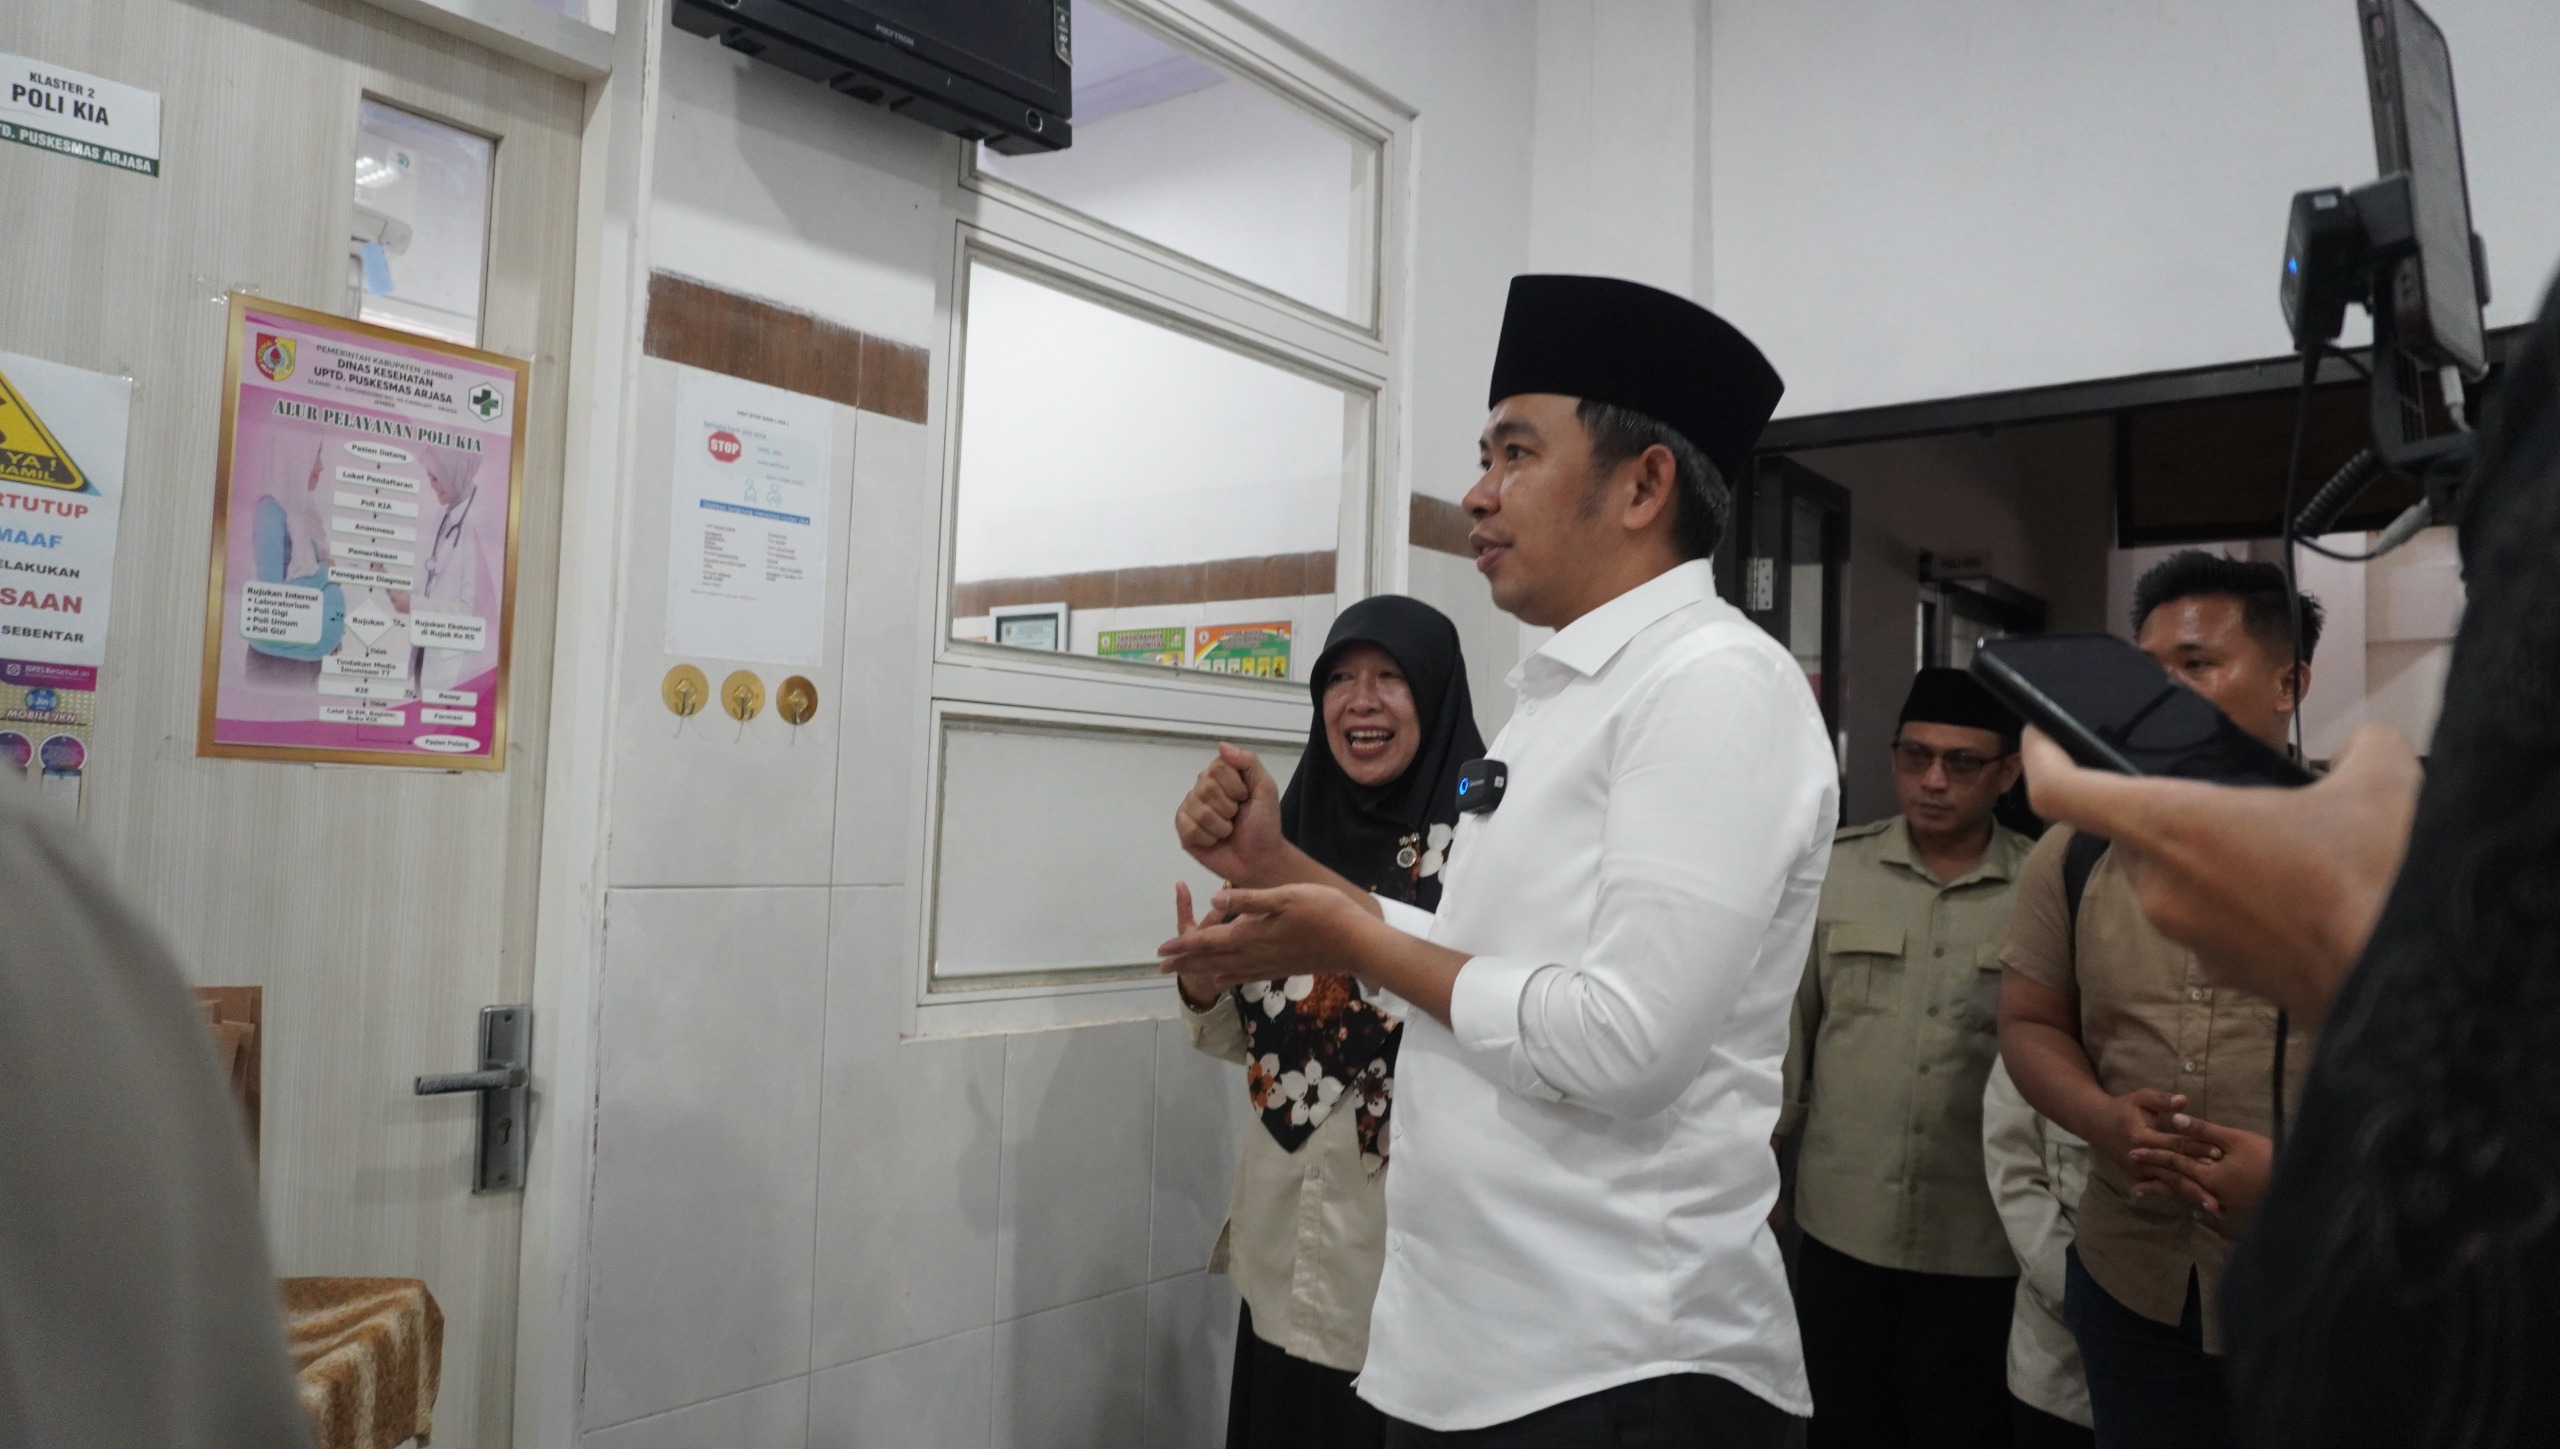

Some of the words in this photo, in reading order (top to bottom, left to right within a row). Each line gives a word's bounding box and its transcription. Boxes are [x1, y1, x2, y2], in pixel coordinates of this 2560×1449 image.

[29, 71, 83, 95] KLASTER
[88, 88, 95, 98] 2
[12, 83, 64, 114] POLI
[74, 100, 109, 126] KIA
[0, 124, 15, 138] D.
[20, 129, 100, 159] PUSKESMAS
[103, 150, 152, 173] ARJASA
[316, 344, 371, 363] PEMERINTAH
[373, 356, 421, 374] KABUPATEN
[423, 367, 454, 381] JEMBER
[338, 358, 371, 375] DINAS
[373, 366, 434, 388] KESEHATAN
[314, 366, 346, 382] UPTD.
[349, 374, 412, 396] PUSKESMAS
[414, 388, 453, 404] ARJASA
[273, 400, 319, 421] ALUR
[323, 408, 413, 440] PELAYANAN
[417, 427, 451, 446] POLI
[455, 437, 482, 453] KIA
[351, 444, 377, 455] Pasien
[379, 448, 407, 461] Datang
[710, 439, 739, 455] STOP
[7, 452, 40, 469] YA
[342, 471, 364, 480] Loket
[366, 474, 413, 489] Pendaftaran
[361, 499, 376, 508] Poli
[377, 502, 392, 510] KIA
[348, 547, 398, 560] Pemeriksaan
[330, 570, 374, 583] Penegakan
[247, 587, 282, 598] Rujukan
[285, 591, 318, 602] Internal
[254, 599, 310, 609] Laboratorium
[253, 607, 269, 615] Poli
[272, 609, 288, 618] Gigi
[252, 626, 268, 634] Poli
[271, 619, 298, 627] Umum
[352, 617, 385, 628] Rujukan
[1, 625, 84, 643] SEBENTAR
[7, 709, 51, 721] MOBILE
[52, 712, 76, 723] JKN
